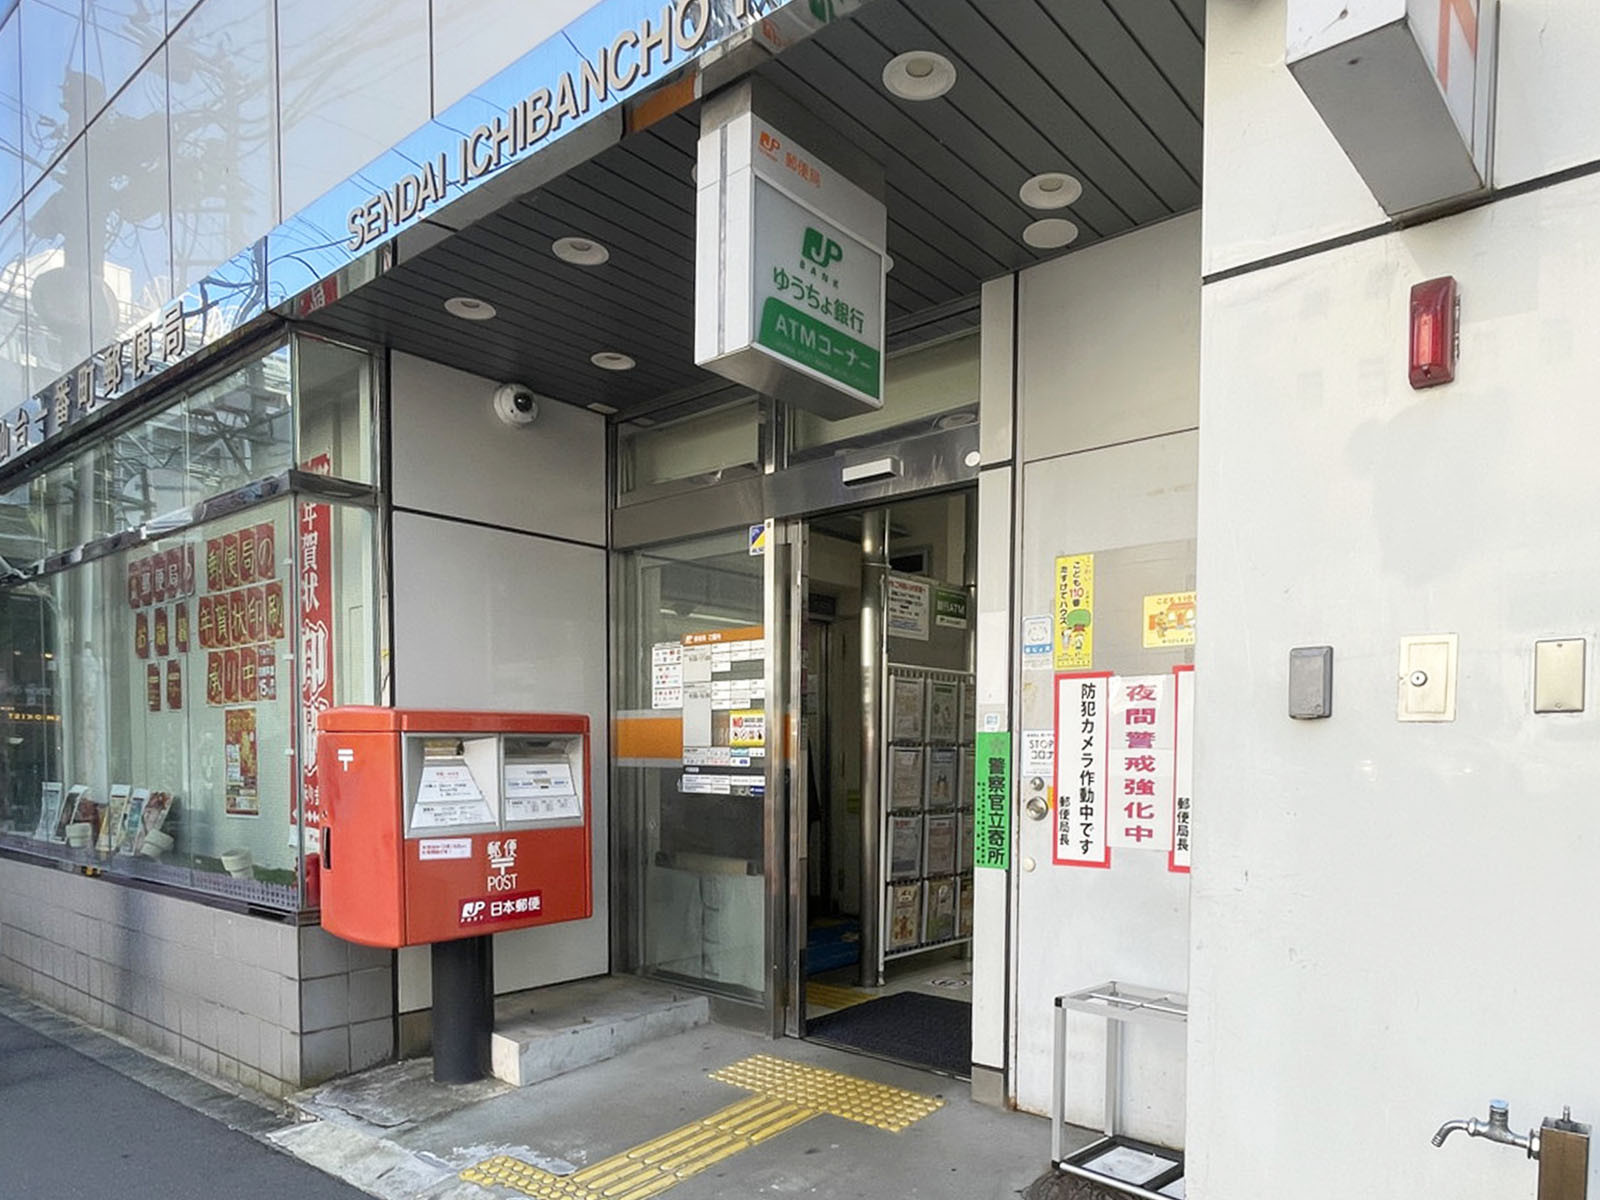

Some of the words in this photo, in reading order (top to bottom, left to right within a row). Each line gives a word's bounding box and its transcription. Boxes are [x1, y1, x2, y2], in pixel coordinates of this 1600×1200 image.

[346, 152, 446, 252] SENDAI
[458, 0, 709, 187] ICHIBANCHO
[773, 266, 865, 334] ゆうちょ銀行
[800, 259, 840, 290] BANK
[775, 313, 872, 370] ATMコーナー
[1079, 683, 1096, 855] 防犯カメラ作動中です
[1123, 684, 1156, 843] 夜間警戒強化中
[987, 757, 1006, 865] 警察官立寄所
[1059, 796, 1071, 846] 郵便局長
[1176, 797, 1191, 851] 郵便局長
[487, 838, 518, 858] 郵便
[487, 874, 518, 891] POST
[490, 896, 541, 917] 日本郵便
